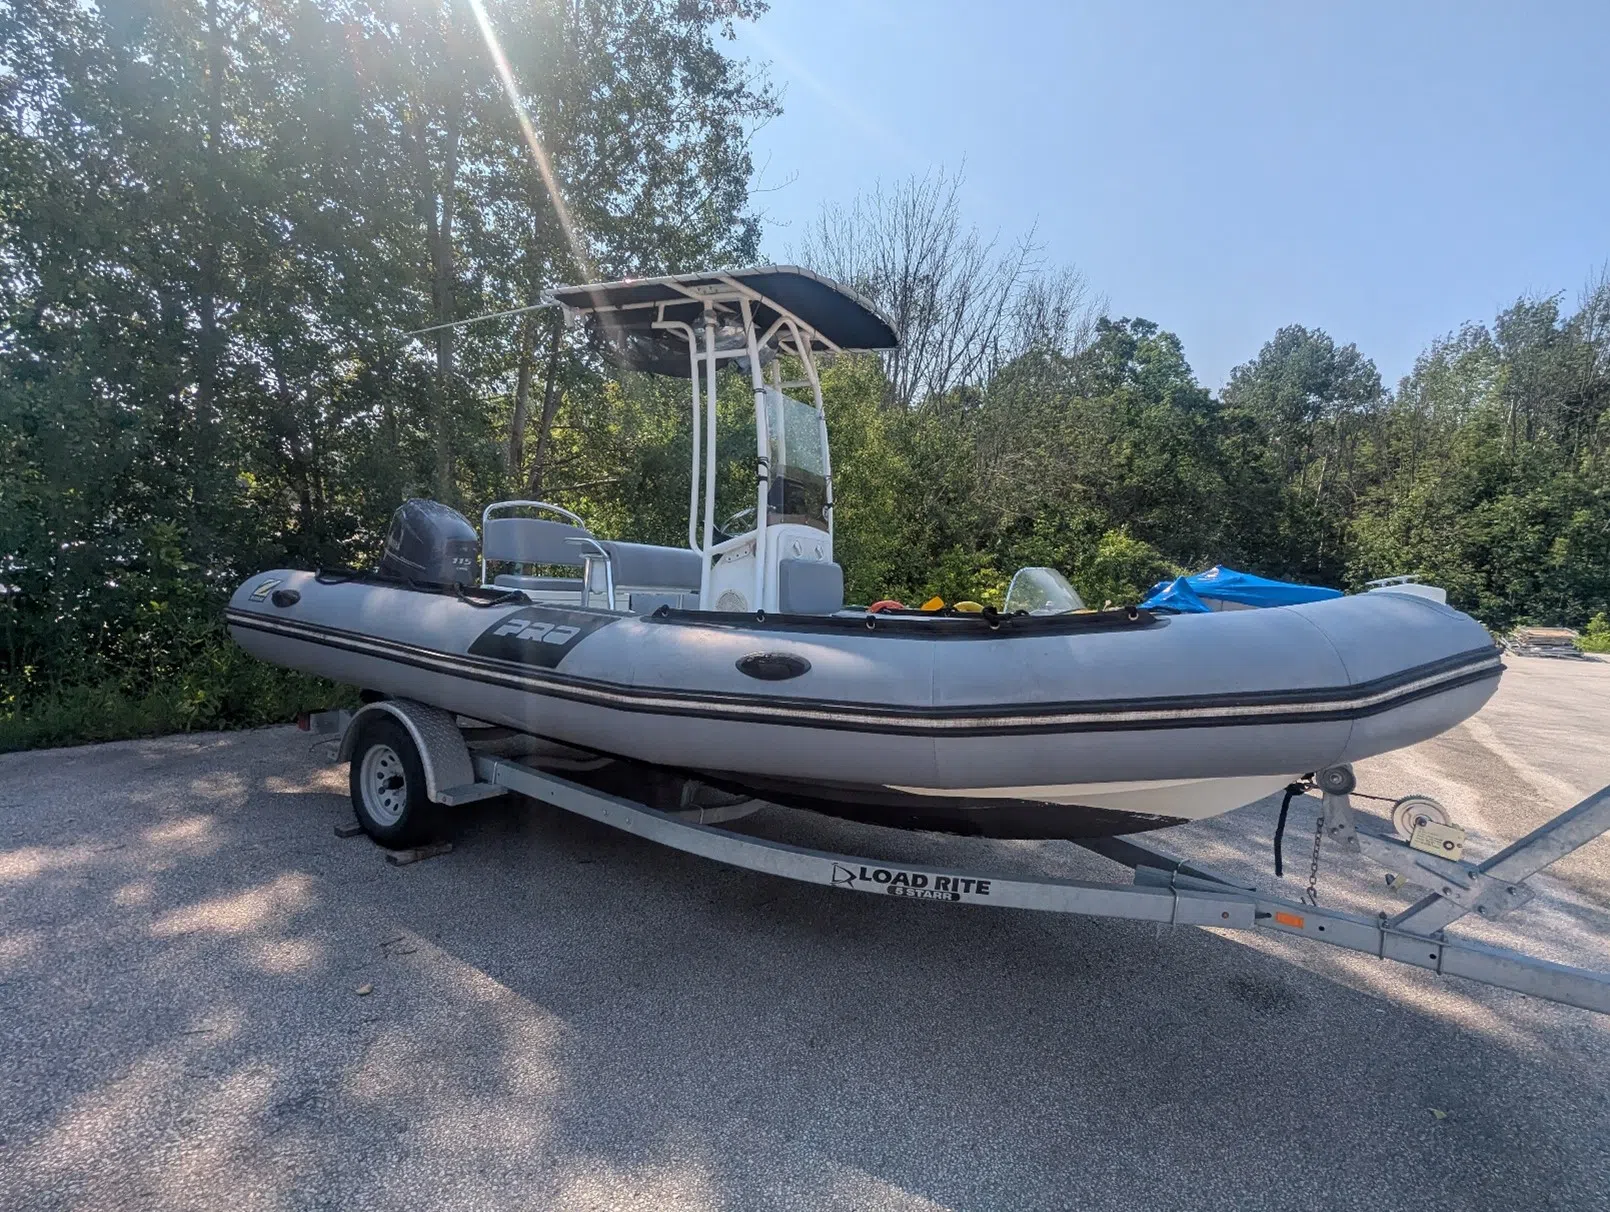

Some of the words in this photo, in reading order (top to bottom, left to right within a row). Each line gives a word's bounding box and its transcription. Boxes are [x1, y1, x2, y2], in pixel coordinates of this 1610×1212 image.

[452, 557, 471, 565] 115
[494, 619, 580, 645] PRO
[859, 866, 928, 888] LOAD
[934, 876, 991, 895] RITE
[895, 887, 904, 896] 5
[906, 889, 952, 901] STARR
